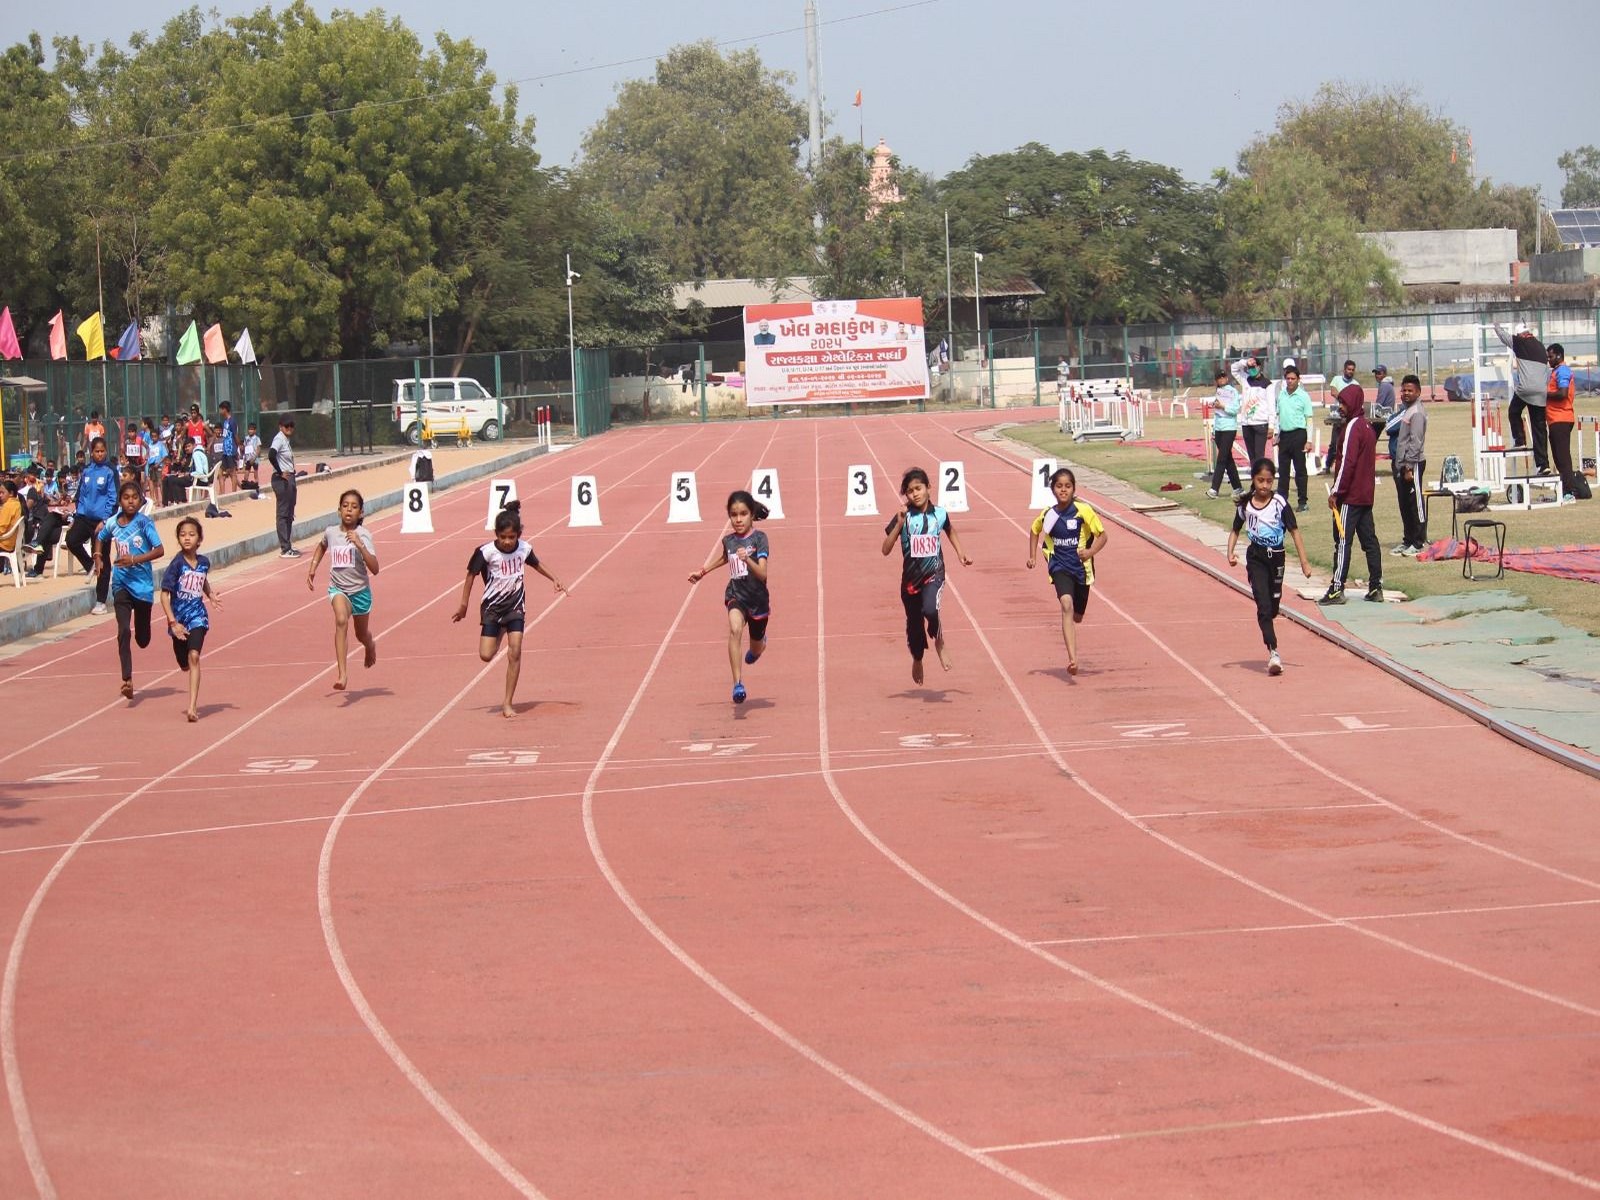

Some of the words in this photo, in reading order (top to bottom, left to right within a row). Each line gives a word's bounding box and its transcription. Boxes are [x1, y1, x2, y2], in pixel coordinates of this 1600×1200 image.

[780, 319, 810, 337] ખેલ
[814, 317, 875, 341] મહાકુંભ
[811, 338, 842, 349] ૨૦૨૫
[853, 471, 868, 495] 3
[945, 467, 960, 492] 2
[1038, 464, 1051, 488] 1
[577, 482, 592, 506] 6
[676, 478, 691, 502] 5
[757, 475, 773, 499] 4
[408, 488, 423, 513] 8
[495, 485, 511, 510] 7
[913, 536, 937, 555] 0838
[333, 547, 353, 565] 0661
[501, 556, 522, 576] 0113
[1112, 723, 1191, 738] 2
[1334, 716, 1391, 730] 1
[681, 742, 758, 756] 4
[898, 733, 973, 748] 3
[466, 750, 542, 766] 5
[24, 766, 103, 782] 7
